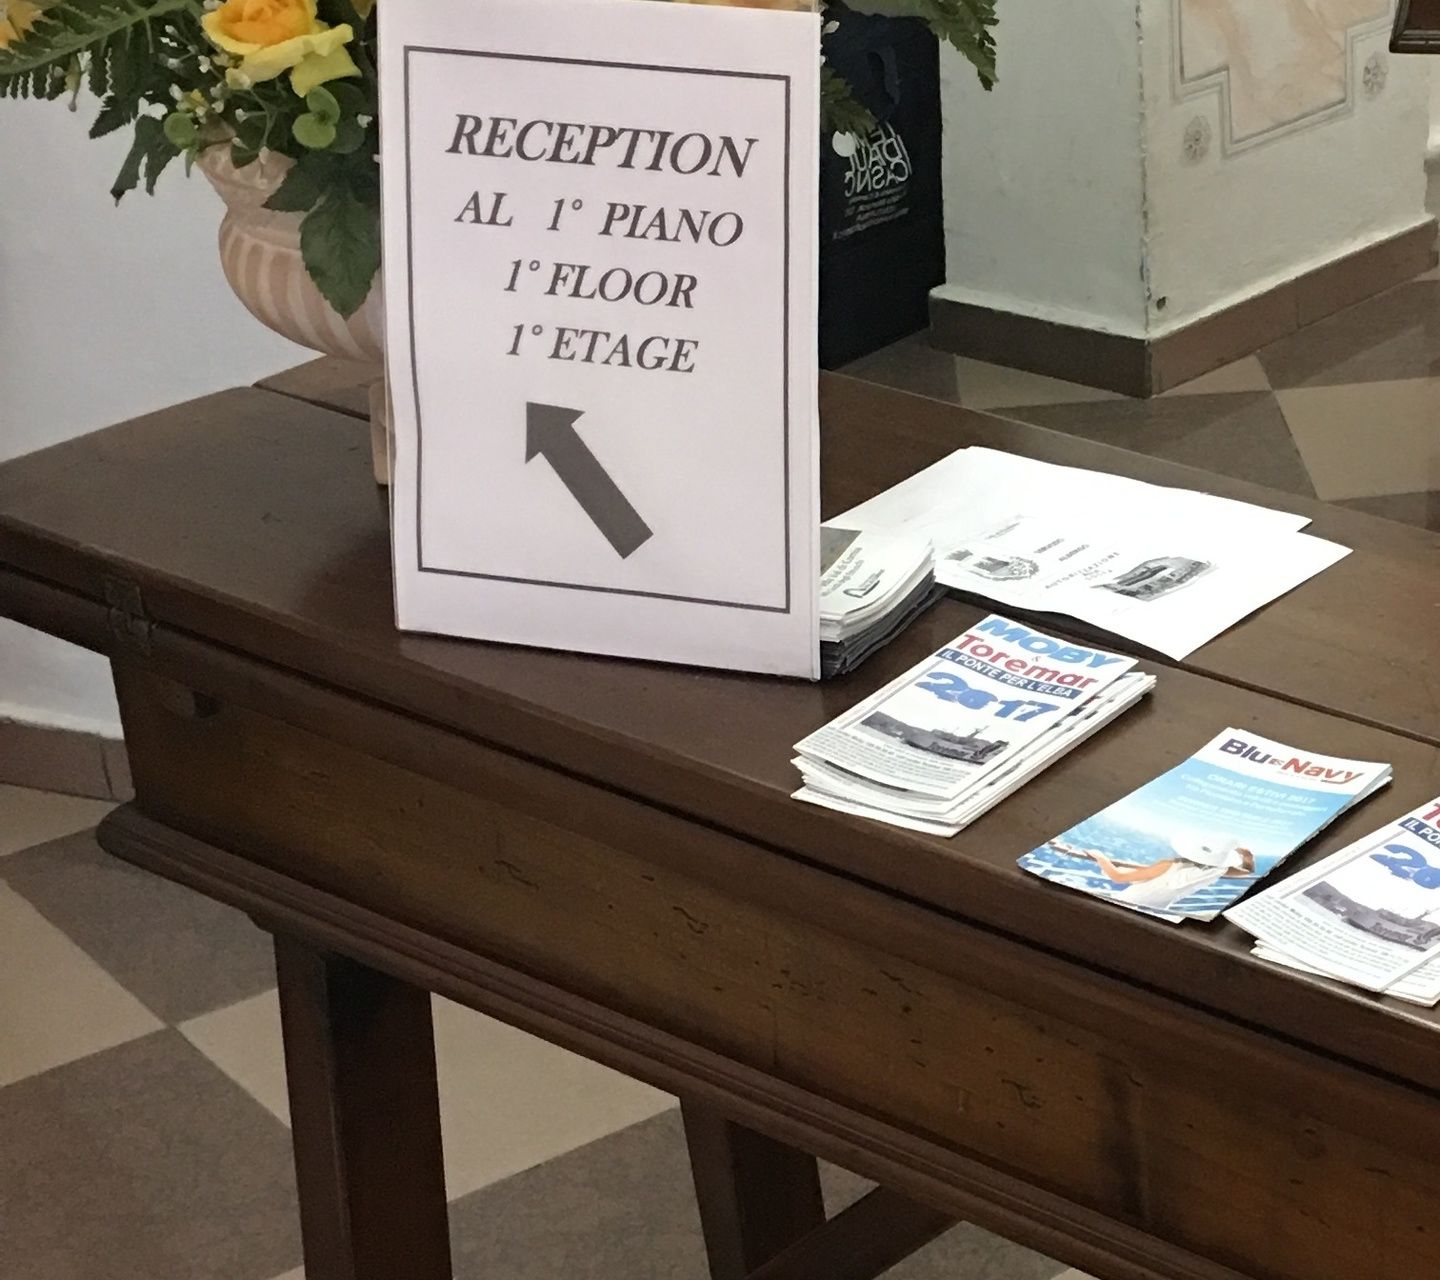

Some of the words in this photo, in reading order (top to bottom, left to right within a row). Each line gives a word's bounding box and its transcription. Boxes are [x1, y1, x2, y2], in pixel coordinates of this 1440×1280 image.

[443, 112, 761, 180] RECEPTION
[452, 189, 514, 228] AL
[597, 201, 745, 248] PIANO
[956, 634, 1099, 689] Toremar
[976, 618, 1125, 668] MOBY
[915, 671, 1061, 723] 2017
[941, 650, 953, 660] IL
[955, 654, 999, 680] PONTE
[999, 673, 1026, 690] PER
[1025, 680, 1073, 698] L'ELBA
[1219, 738, 1272, 764] Blu
[1282, 757, 1365, 785] Navy
[1404, 819, 1418, 831] IL
